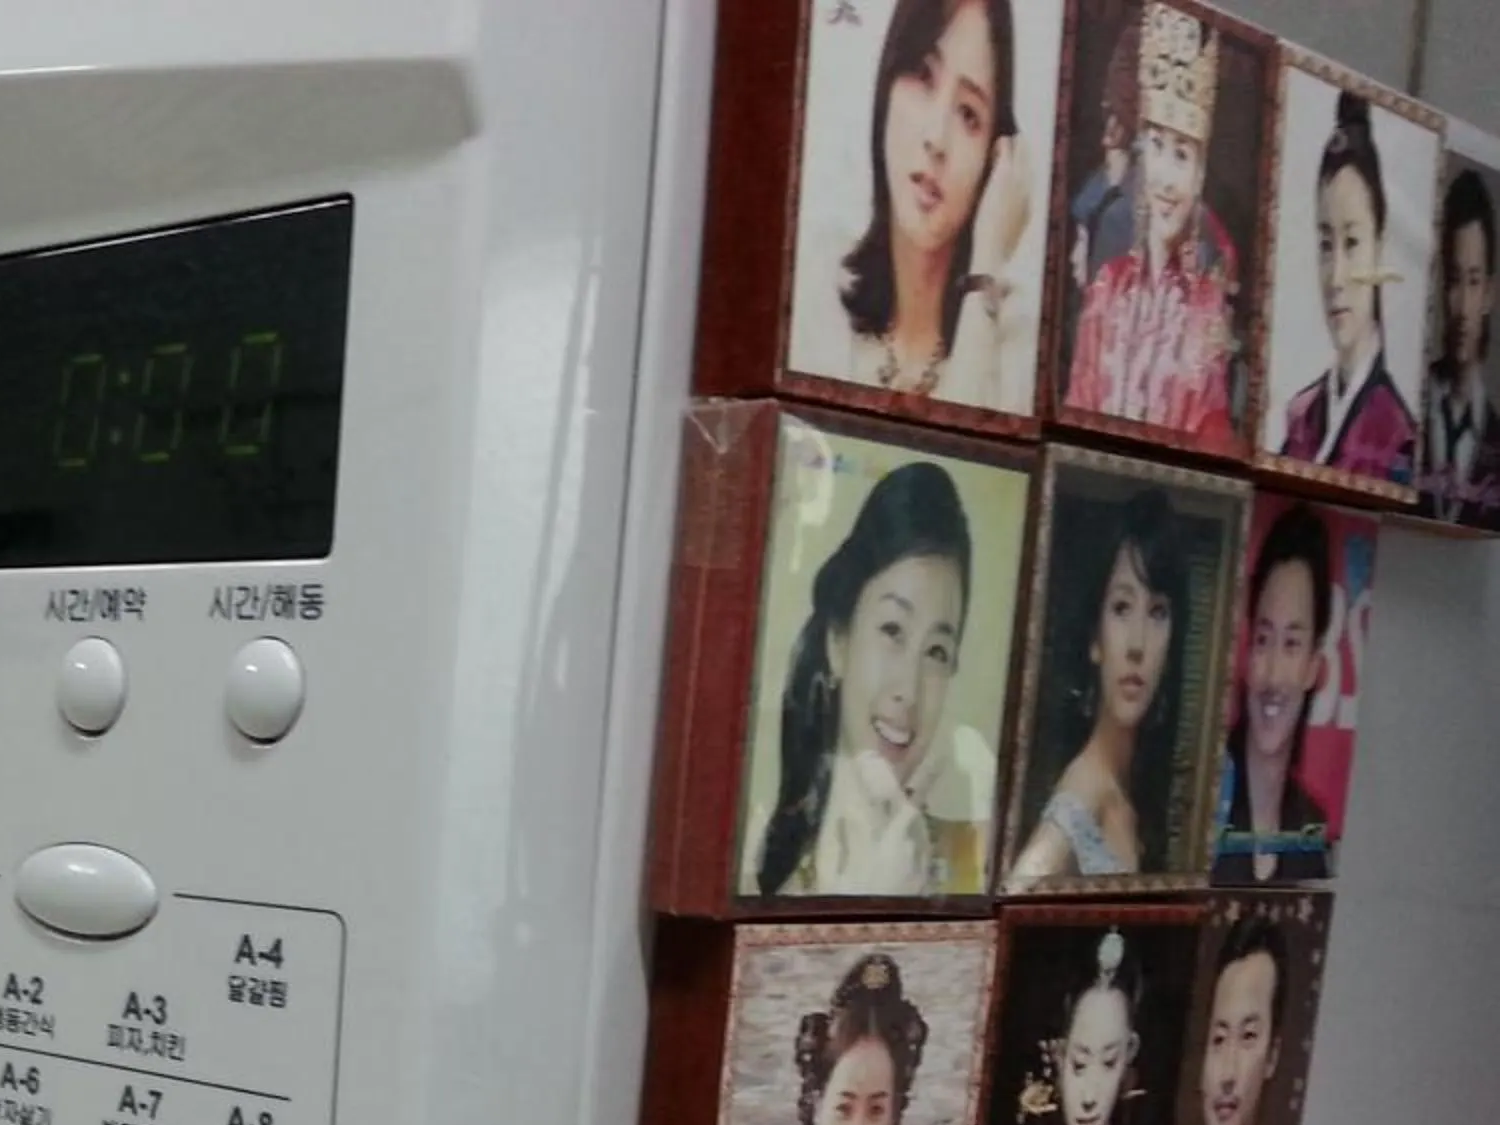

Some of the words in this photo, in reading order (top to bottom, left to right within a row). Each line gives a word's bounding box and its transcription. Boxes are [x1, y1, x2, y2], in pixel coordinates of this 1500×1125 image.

[45, 587, 148, 622] 시간/예약
[208, 583, 325, 622] 시간/해동
[234, 934, 285, 969] A-4
[3, 972, 45, 1005] A-2
[121, 991, 168, 1026] A-3
[117, 1084, 164, 1120] A-7
